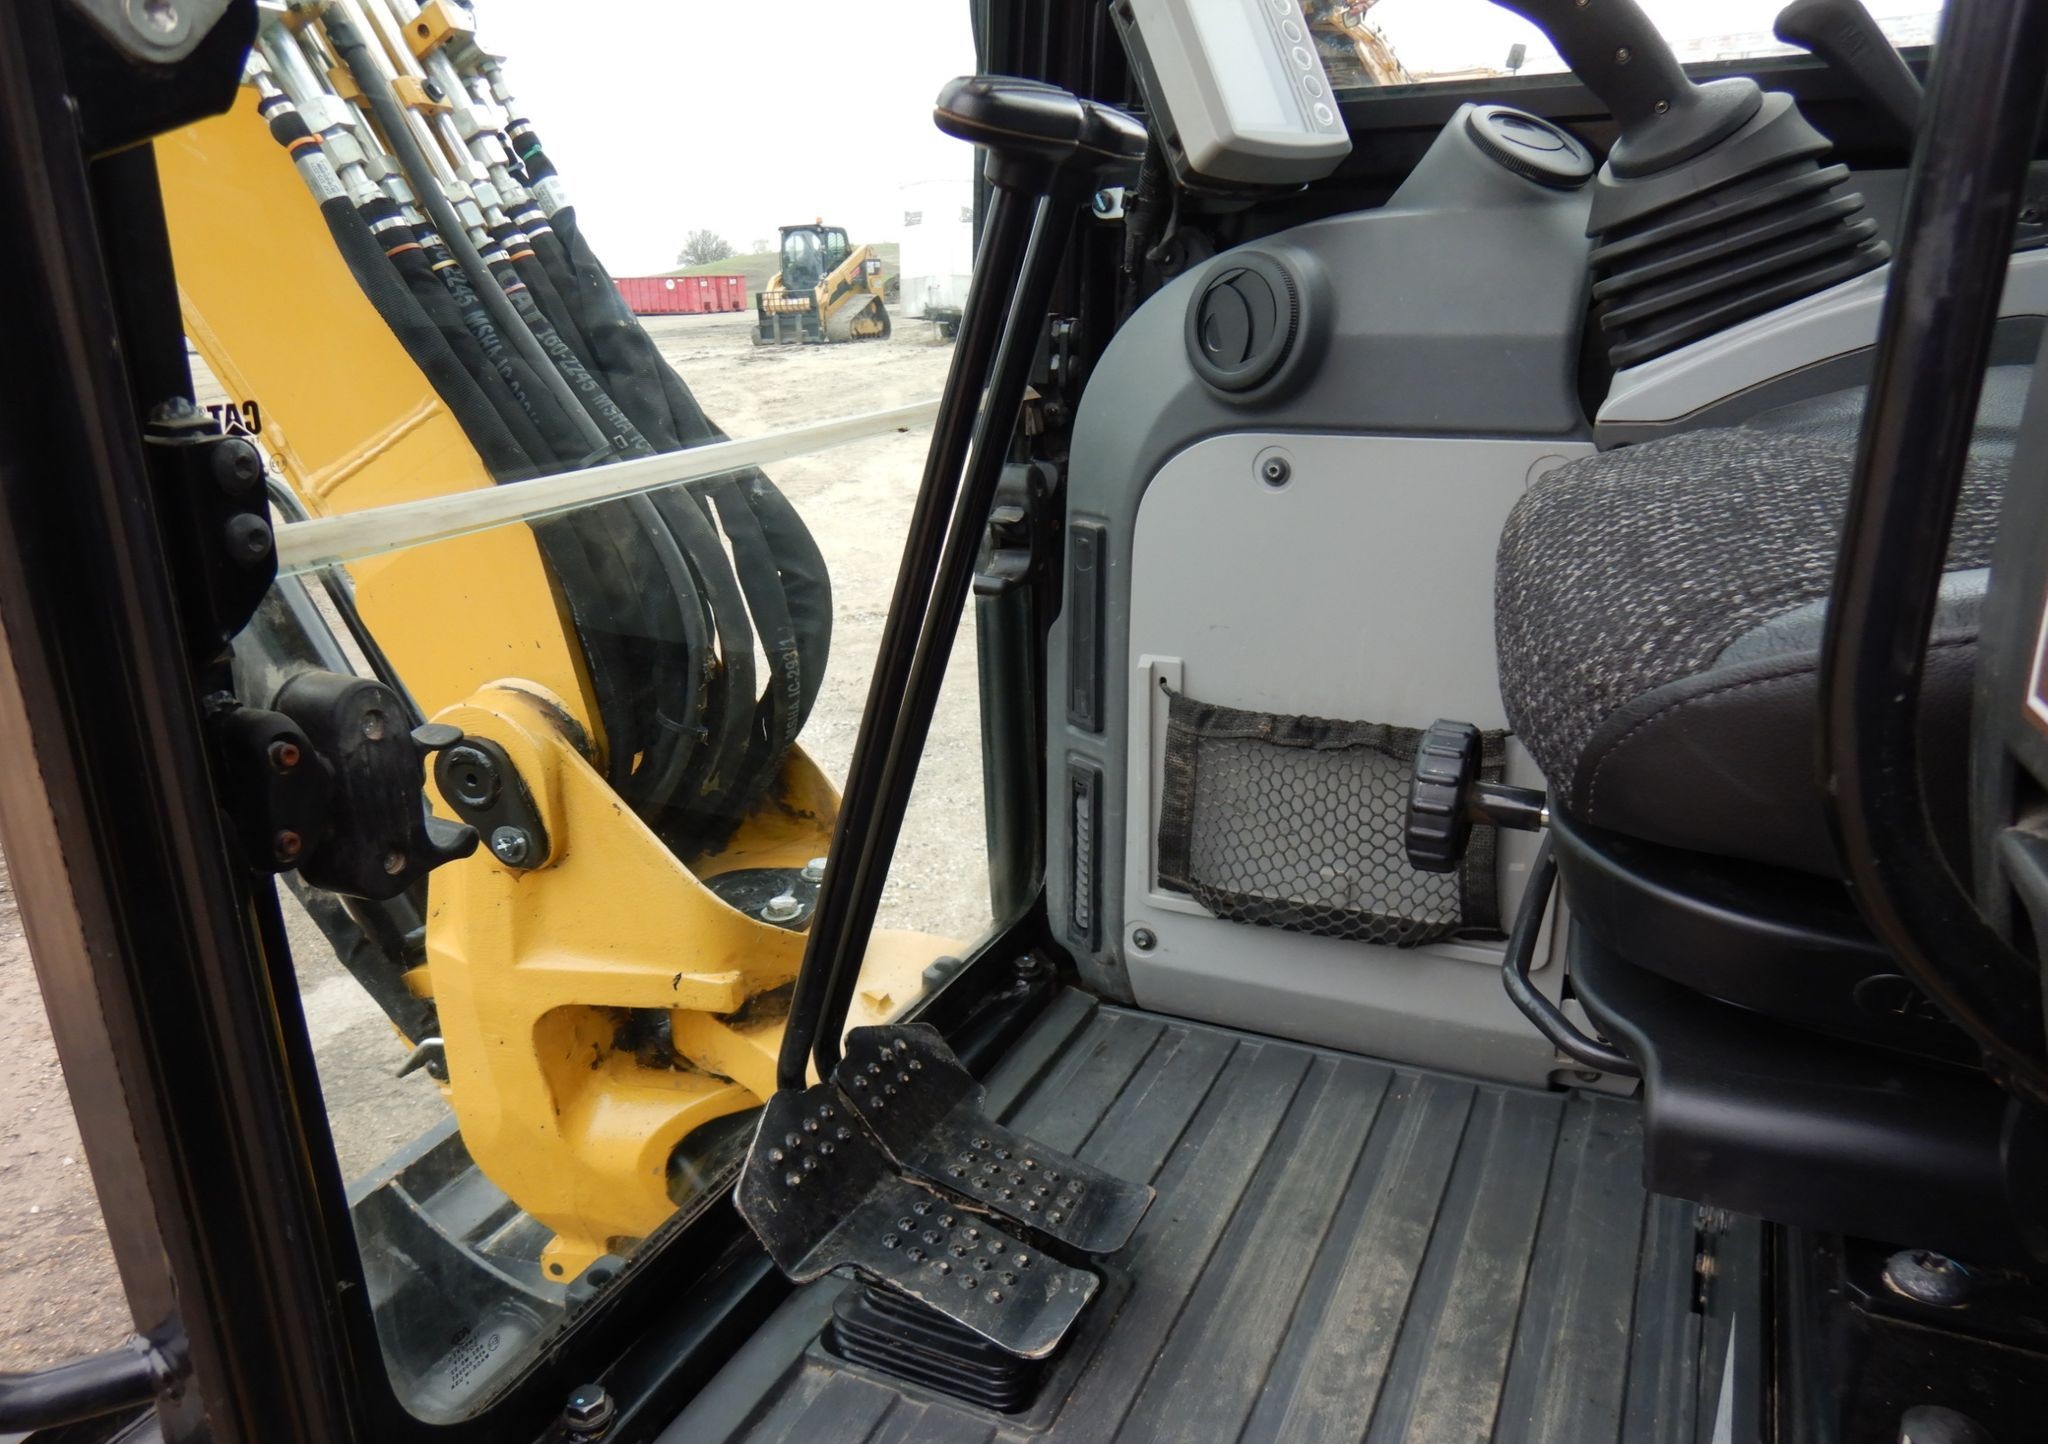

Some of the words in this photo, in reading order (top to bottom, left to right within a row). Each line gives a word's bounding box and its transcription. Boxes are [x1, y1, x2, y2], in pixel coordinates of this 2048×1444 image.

[464, 309, 504, 358] MSHA
[496, 268, 548, 325] CAT
[535, 327, 596, 392] 160-2245
[592, 392, 634, 434] MSHA
